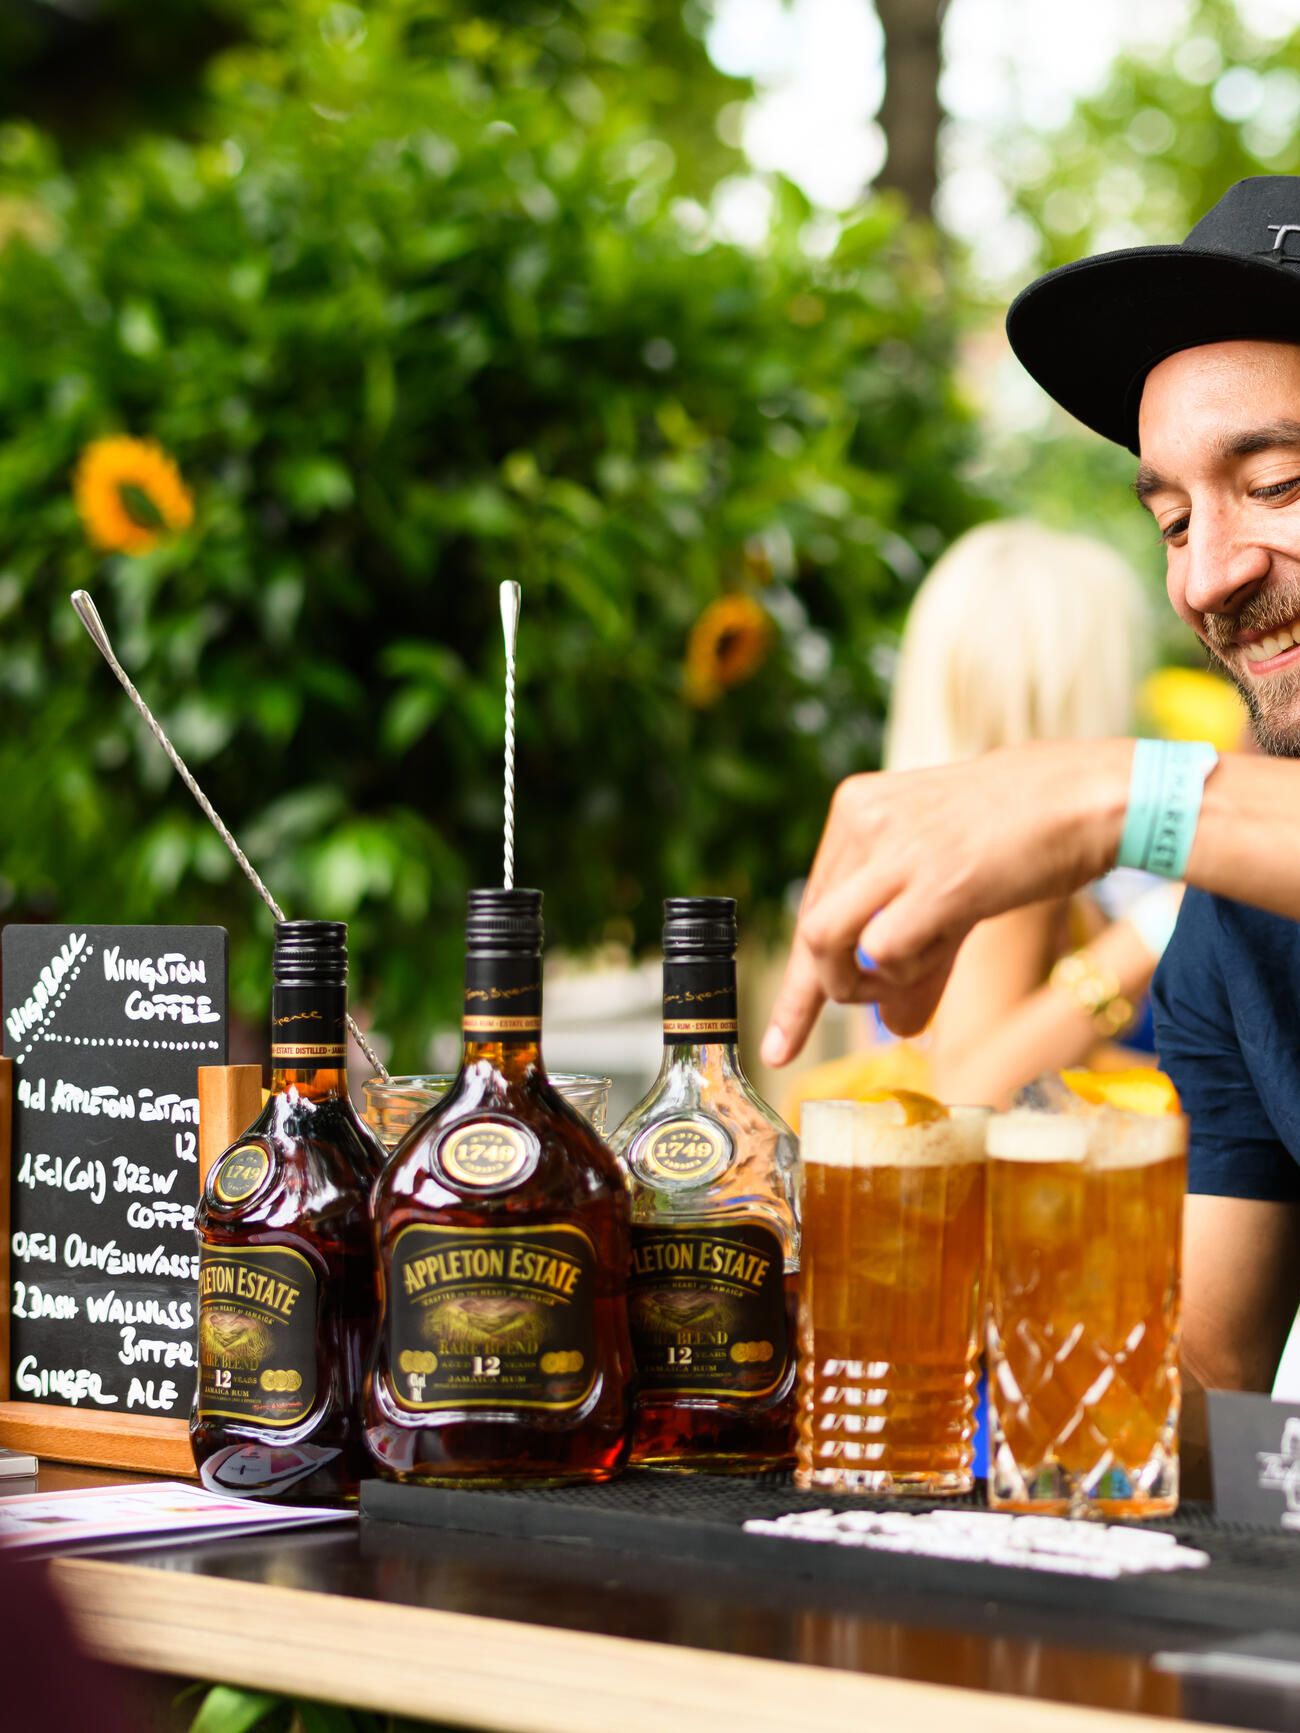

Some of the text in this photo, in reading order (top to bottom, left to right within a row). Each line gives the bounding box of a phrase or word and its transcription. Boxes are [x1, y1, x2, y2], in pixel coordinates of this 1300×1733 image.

[103, 946, 207, 992] KINGSTON
[124, 990, 221, 1024] COFFEE
[295, 1047, 328, 1055] DISTILLED
[51, 1079, 136, 1119] APPLETON
[175, 1131, 198, 1163] 12
[457, 1144, 515, 1162] 1749
[656, 1142, 712, 1158] 1749
[112, 1155, 178, 1194] BREW
[225, 1164, 261, 1180] 1749
[127, 1201, 198, 1231] COFFE
[64, 1233, 200, 1280] OLIVENWASSE
[403, 1248, 582, 1294] APPLETON ESTATE
[699, 1242, 770, 1287] ESTATE
[236, 1267, 300, 1315] ESTATE
[87, 1290, 194, 1330] WALNUSS
[118, 1326, 199, 1368] BITTER
[667, 1347, 693, 1365] 12
[16, 1355, 179, 1410] GINGER ALE
[215, 1369, 232, 1388] 12
[472, 1356, 501, 1376] 12
